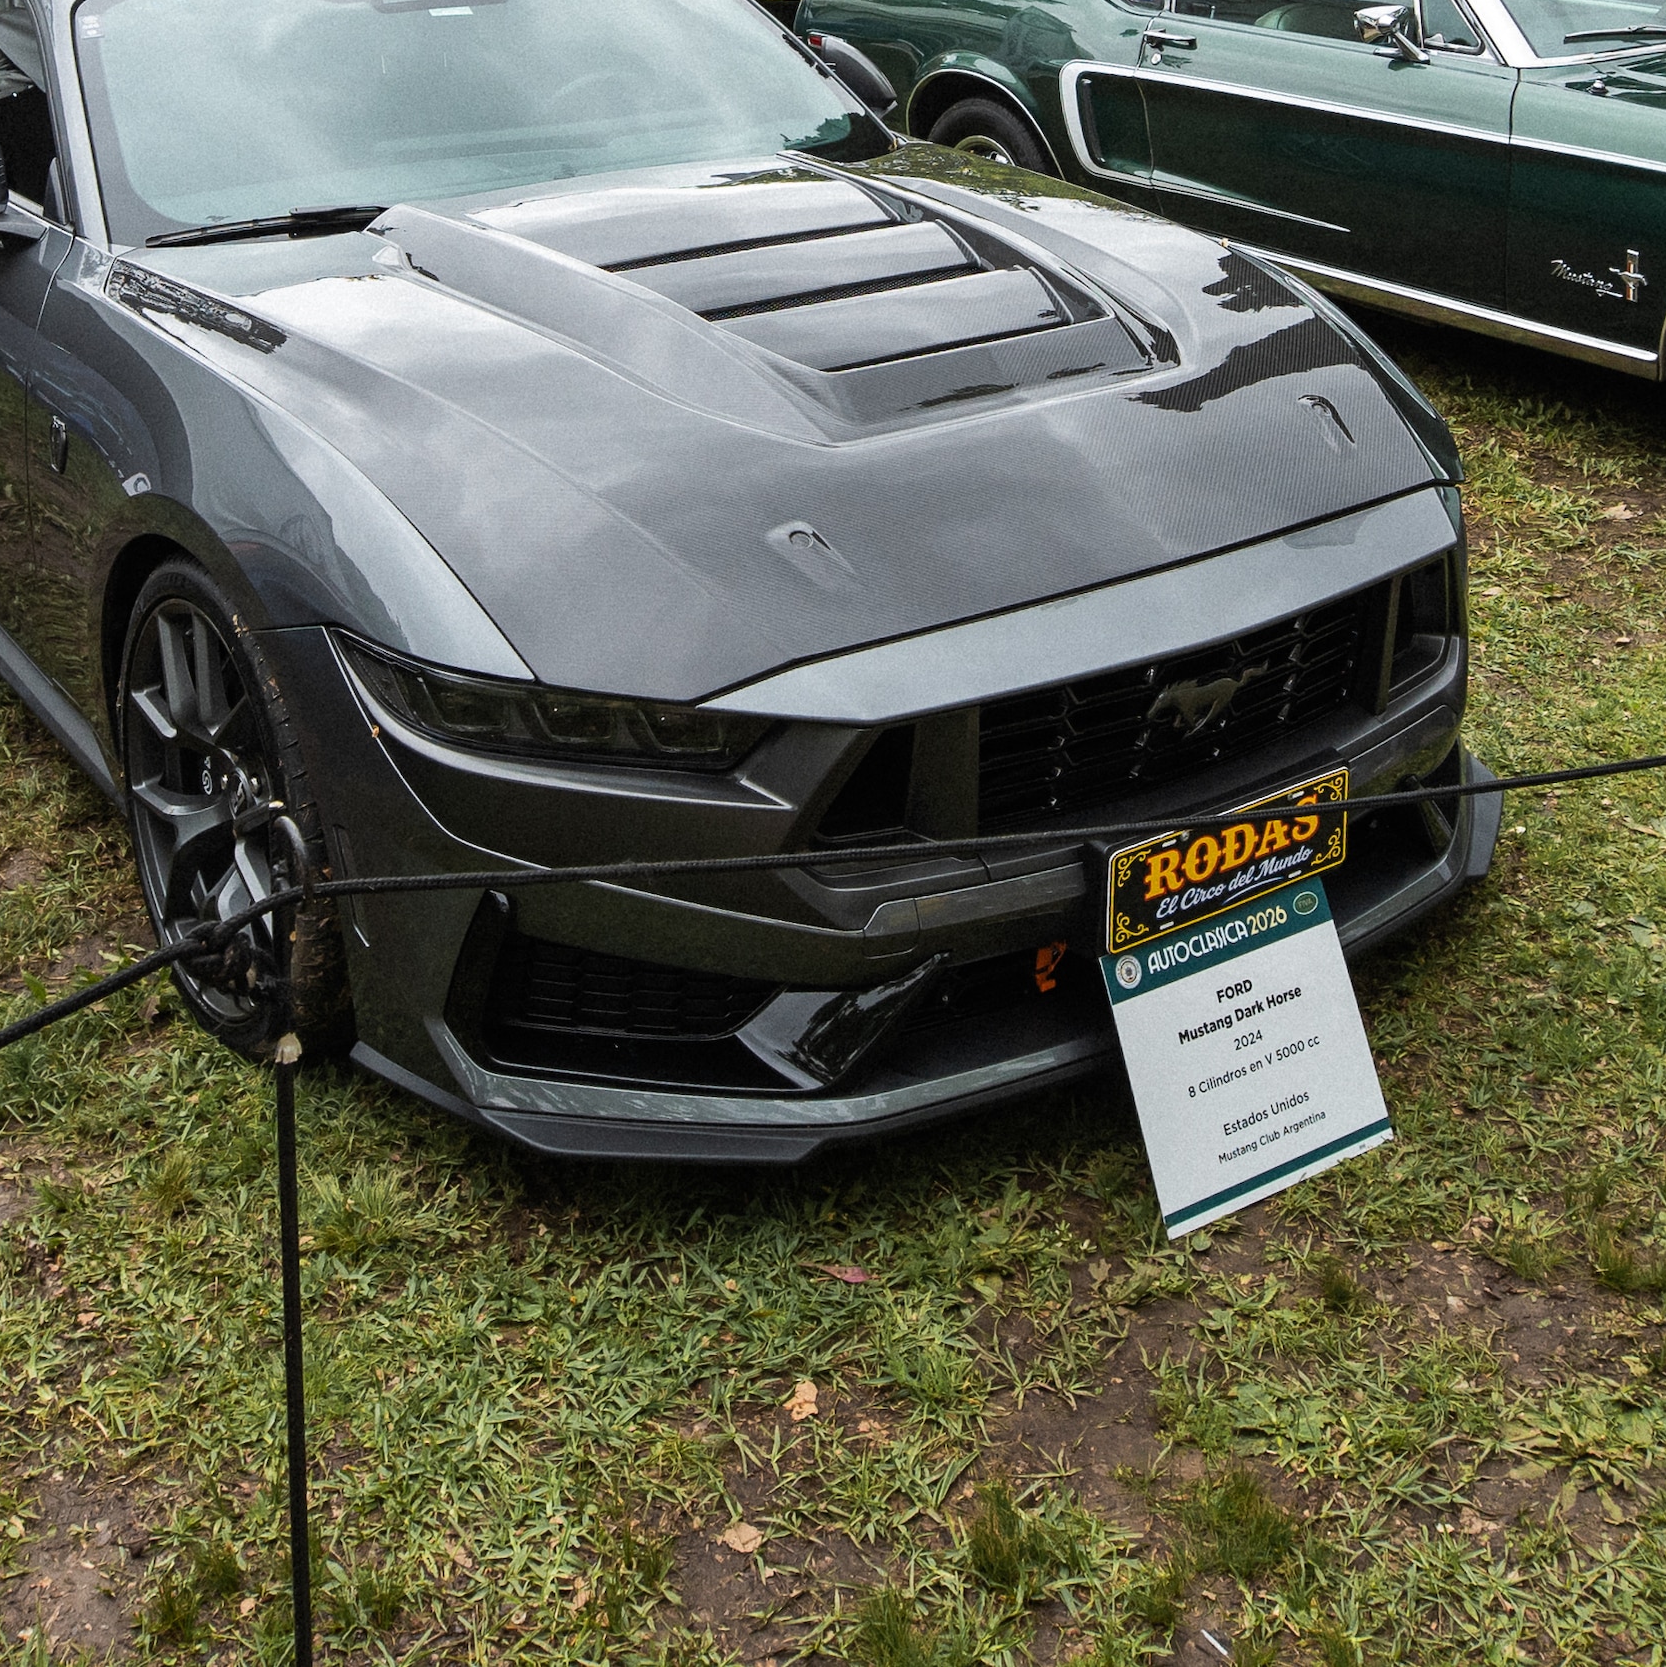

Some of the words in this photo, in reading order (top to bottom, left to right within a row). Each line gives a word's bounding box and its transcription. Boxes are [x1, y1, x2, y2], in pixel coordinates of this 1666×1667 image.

[1551, 259, 1624, 297] Mustang
[1144, 793, 1320, 901] RODAS
[1156, 898, 1179, 920] El
[1180, 884, 1227, 912] Circo
[1228, 869, 1258, 891] del
[1254, 844, 1314, 884] Mundo
[1246, 904, 1288, 936] 2026
[1178, 1014, 1234, 1045] Mustang
[1234, 1000, 1265, 1022] Dark
[1266, 986, 1302, 1010] Horse
[1216, 979, 1253, 1004] FORD
[1233, 1029, 1264, 1051] 2024
[1188, 1086, 1197, 1099] 8
[1198, 1065, 1248, 1094] Cilindros
[1249, 1059, 1264, 1073] en
[1264, 1052, 1274, 1065] V
[1276, 1040, 1306, 1061] 5000
[1307, 1034, 1321, 1048] cc
[1218, 1141, 1259, 1165] Mustang
[1259, 1129, 1282, 1146] Club
[1283, 1110, 1327, 1137] Argentina
[1223, 1108, 1270, 1137] Estados
[1270, 1090, 1311, 1116] Unidos
